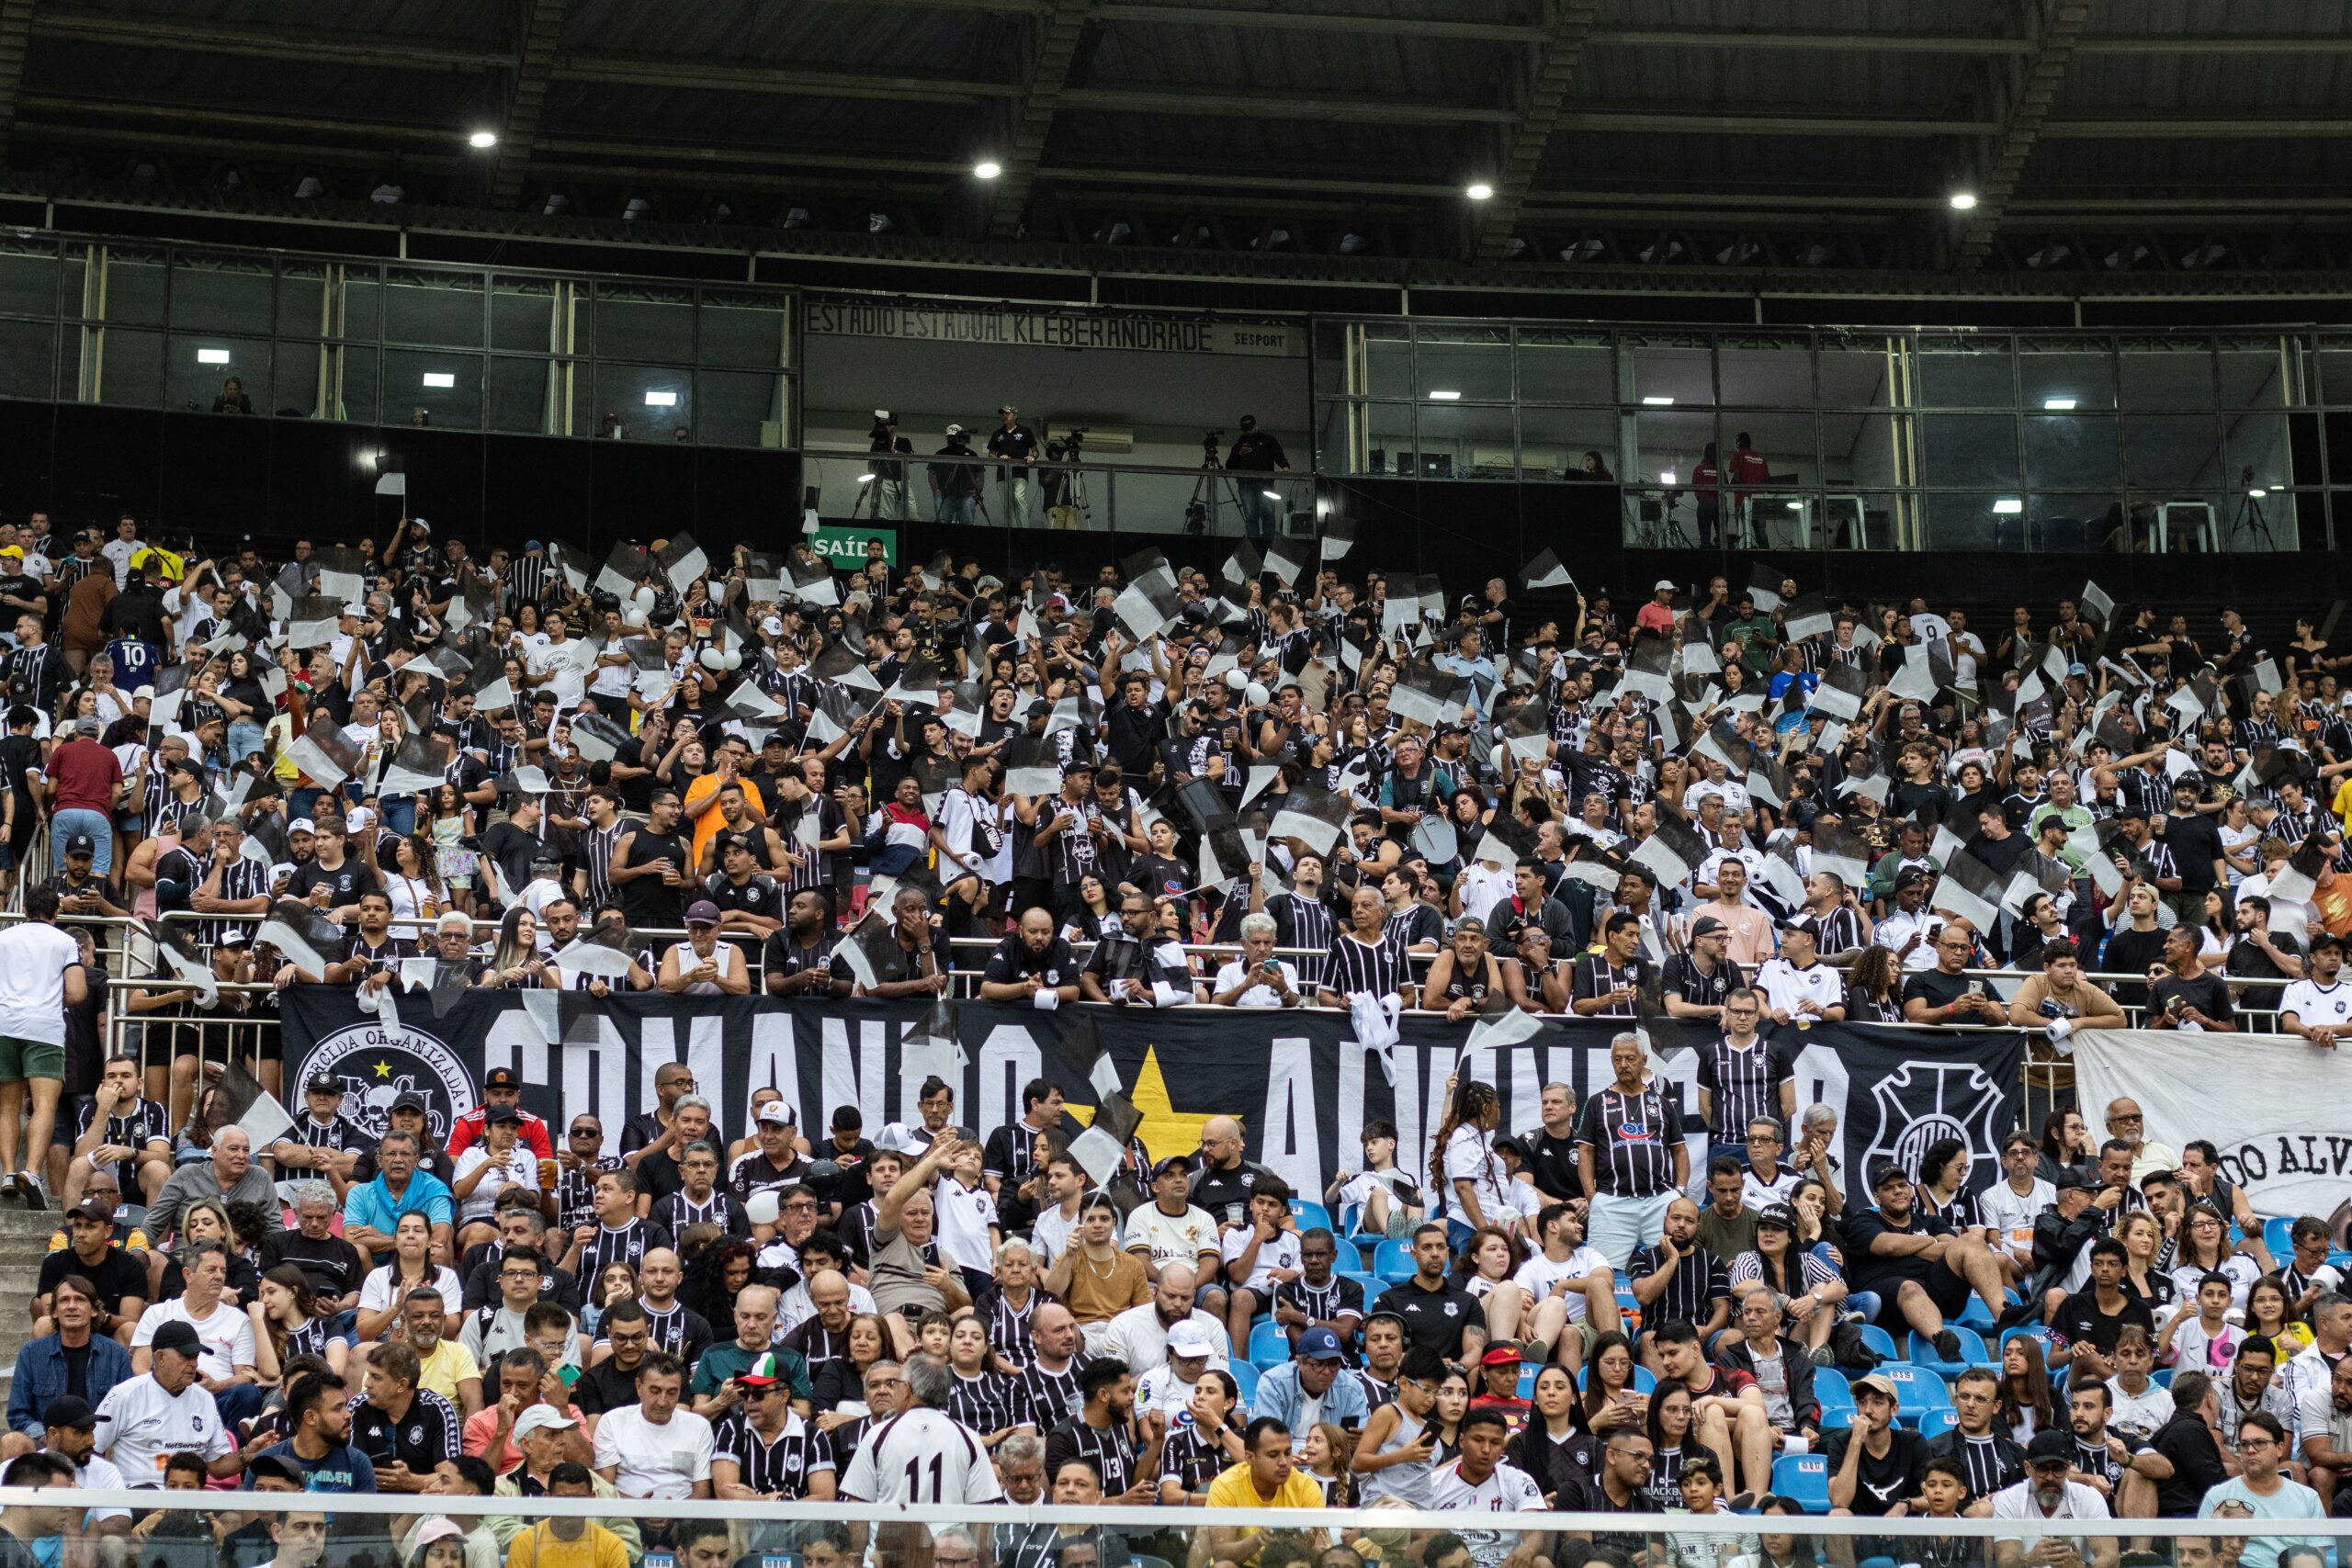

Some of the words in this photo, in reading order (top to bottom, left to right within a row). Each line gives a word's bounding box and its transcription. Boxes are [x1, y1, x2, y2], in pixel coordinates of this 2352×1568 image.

[1013, 313, 1102, 346] KLEBER
[1107, 321, 1213, 351] ANDRADE
[1234, 332, 1284, 347] SESPORT
[1926, 625, 1938, 640] 9
[122, 646, 146, 667] 10
[2026, 712, 2052, 727] Emirates
[2278, 1135, 2352, 1177] ALV
[1105, 1457, 1122, 1479] 13
[301, 1470, 352, 1486] MAIDEN
[905, 1451, 943, 1505] 11
[1642, 1487, 1681, 1495] BLACKB
